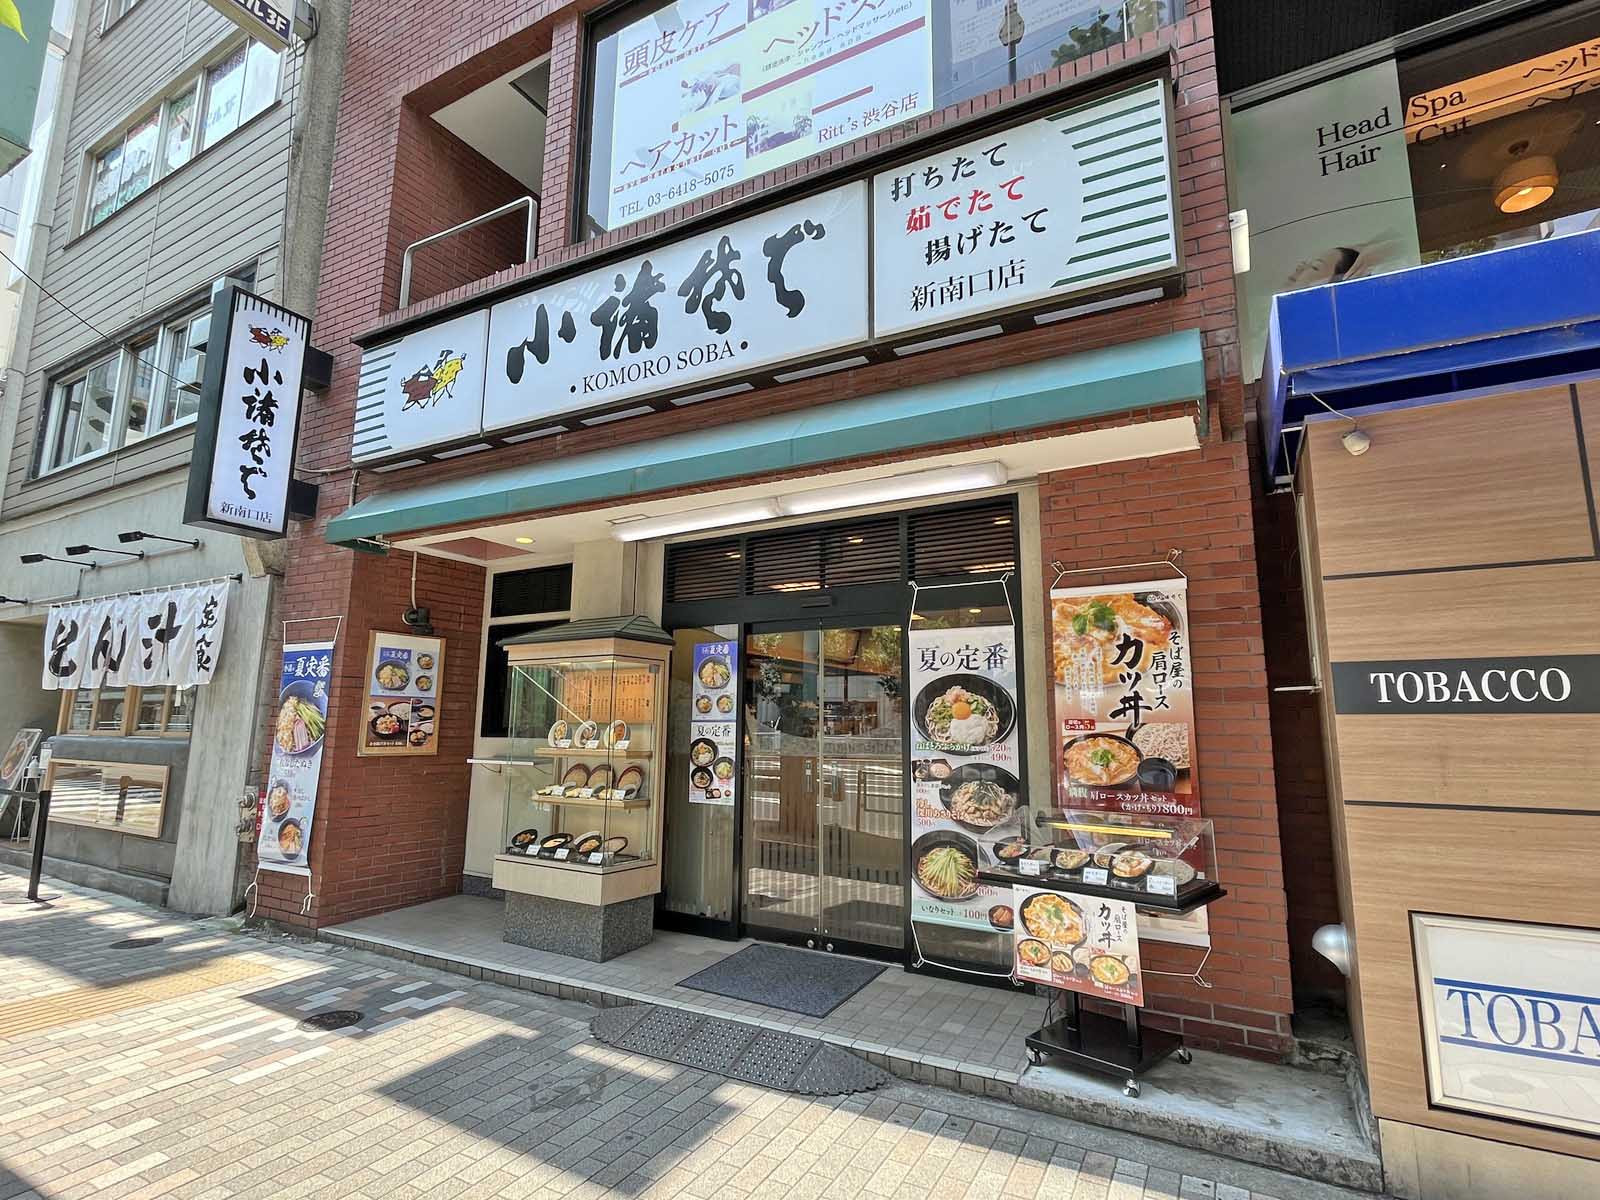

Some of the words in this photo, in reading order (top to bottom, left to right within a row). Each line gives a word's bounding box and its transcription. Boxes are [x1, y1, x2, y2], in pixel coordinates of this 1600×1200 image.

[622, 2, 731, 77] 頭皮ケア
[763, 0, 885, 53] ヘッドス
[862, 93, 919, 126] 渋谷店
[1316, 107, 1392, 148] Head
[1411, 89, 1467, 119] Spa
[620, 115, 738, 175] ヘアカット
[891, 143, 1007, 201] 打ちたて
[1319, 143, 1381, 177] Hair
[1415, 116, 1471, 146] Cut
[620, 201, 644, 218] TEL
[648, 165, 735, 208] 03-6418-5075
[906, 176, 1025, 235] 茹でたて
[925, 208, 1049, 265] 揚げたて
[910, 260, 1025, 311] 新南口店
[582, 356, 671, 394] KOMORO
[676, 341, 736, 373] SOBA
[219, 501, 273, 524] 新南口店
[48, 601, 182, 678] とん汁
[917, 642, 1009, 672] 夏の定番
[1168, 631, 1185, 689] そば屋の
[1109, 633, 1152, 740] カツ丼
[1150, 651, 1169, 710] 肩ロース
[1370, 667, 1571, 704] TOBACCO
[1098, 903, 1116, 948] カツ丼
